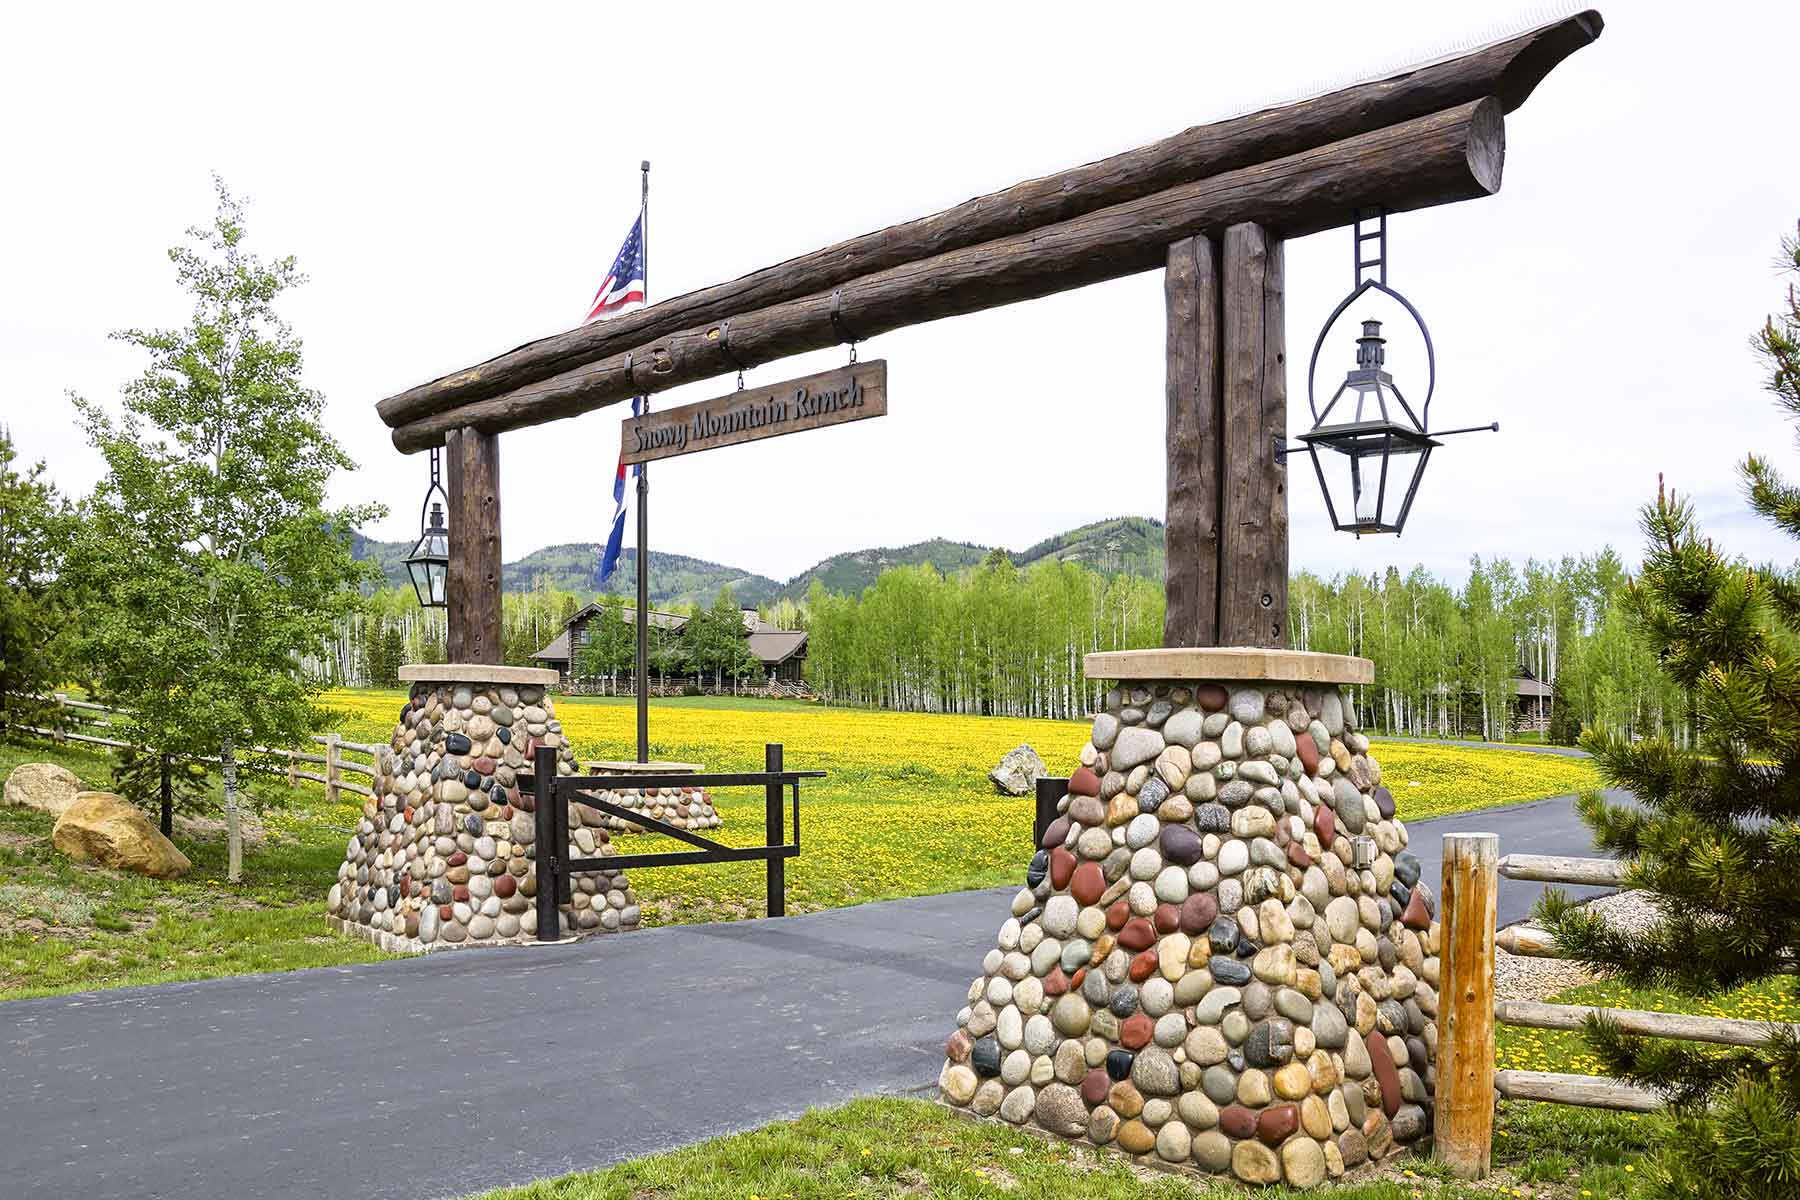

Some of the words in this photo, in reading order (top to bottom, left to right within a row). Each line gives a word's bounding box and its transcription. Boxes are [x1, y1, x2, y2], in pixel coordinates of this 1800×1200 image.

[633, 422, 688, 454] Snowy
[692, 395, 787, 440] Mountain
[793, 376, 865, 419] Ranch
